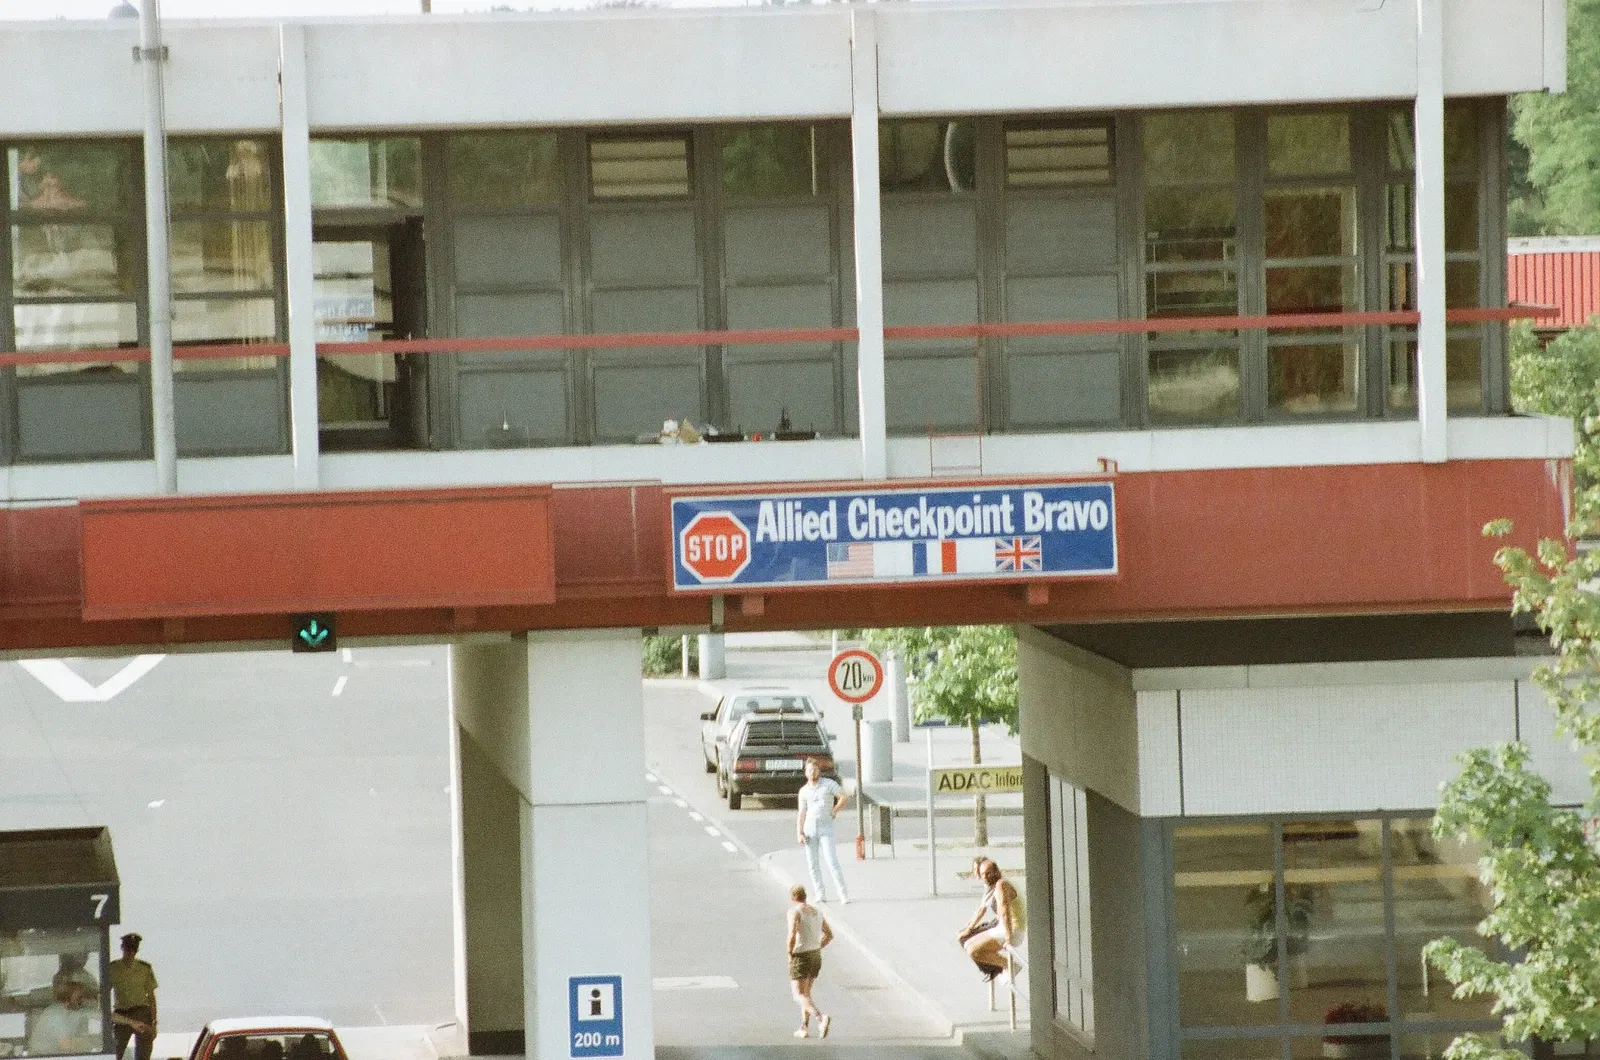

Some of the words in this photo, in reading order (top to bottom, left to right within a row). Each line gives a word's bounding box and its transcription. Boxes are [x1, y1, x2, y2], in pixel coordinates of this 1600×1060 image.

[756, 499, 838, 543] Allied
[847, 493, 1015, 541] Checkpoint
[1023, 491, 1109, 533] Bravo
[688, 534, 743, 562] STOP
[841, 661, 862, 690] 20
[938, 771, 991, 791] ADAC
[90, 894, 109, 919] 7
[574, 1032, 601, 1048] 200
[605, 1034, 620, 1047] m
